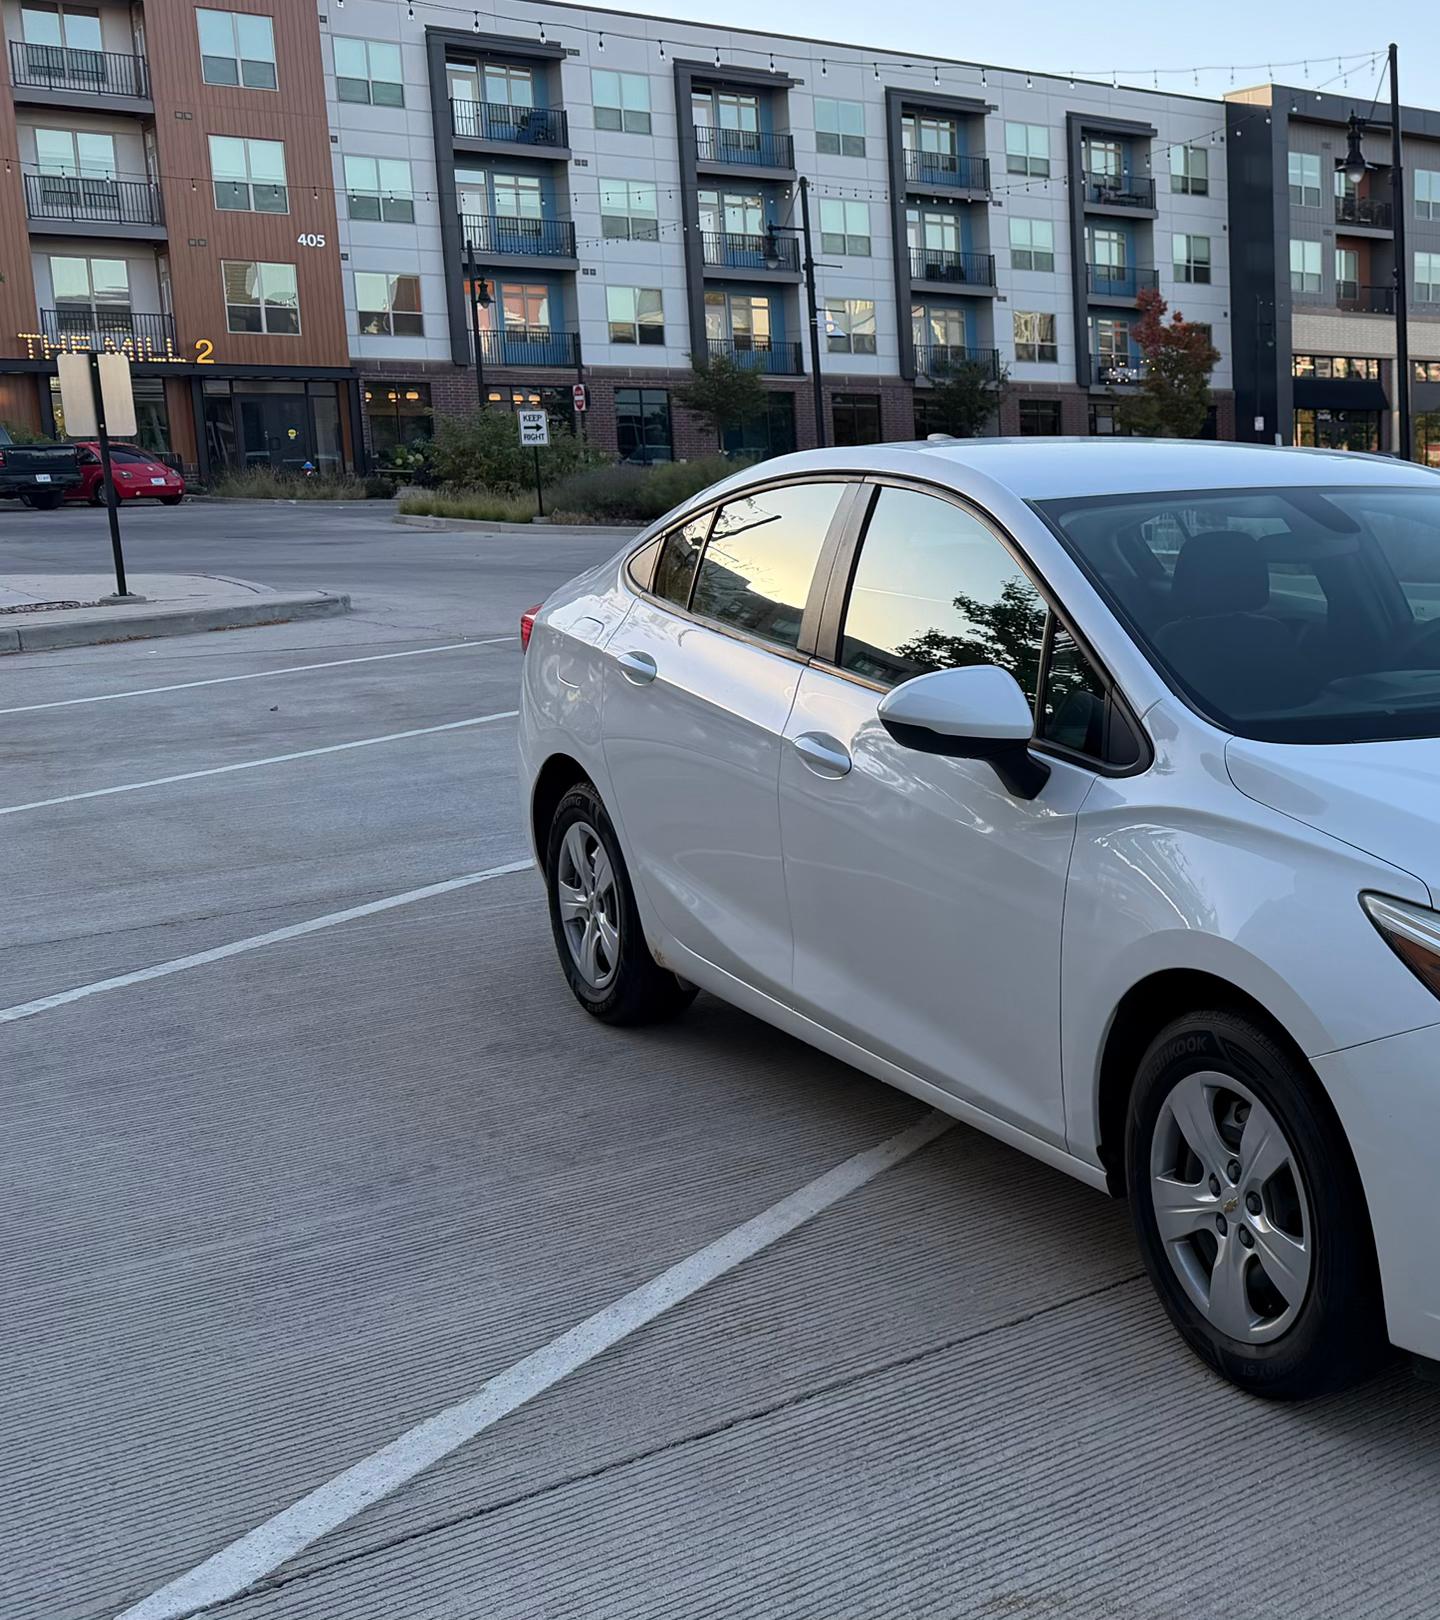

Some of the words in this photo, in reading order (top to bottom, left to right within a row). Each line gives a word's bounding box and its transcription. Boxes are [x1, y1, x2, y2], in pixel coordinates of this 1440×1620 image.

[297, 233, 326, 248] 405
[17, 333, 91, 360] THE
[103, 336, 187, 362] MILL
[194, 339, 215, 364] 2
[523, 414, 543, 422] KEEP
[523, 433, 545, 441] RIGHT
